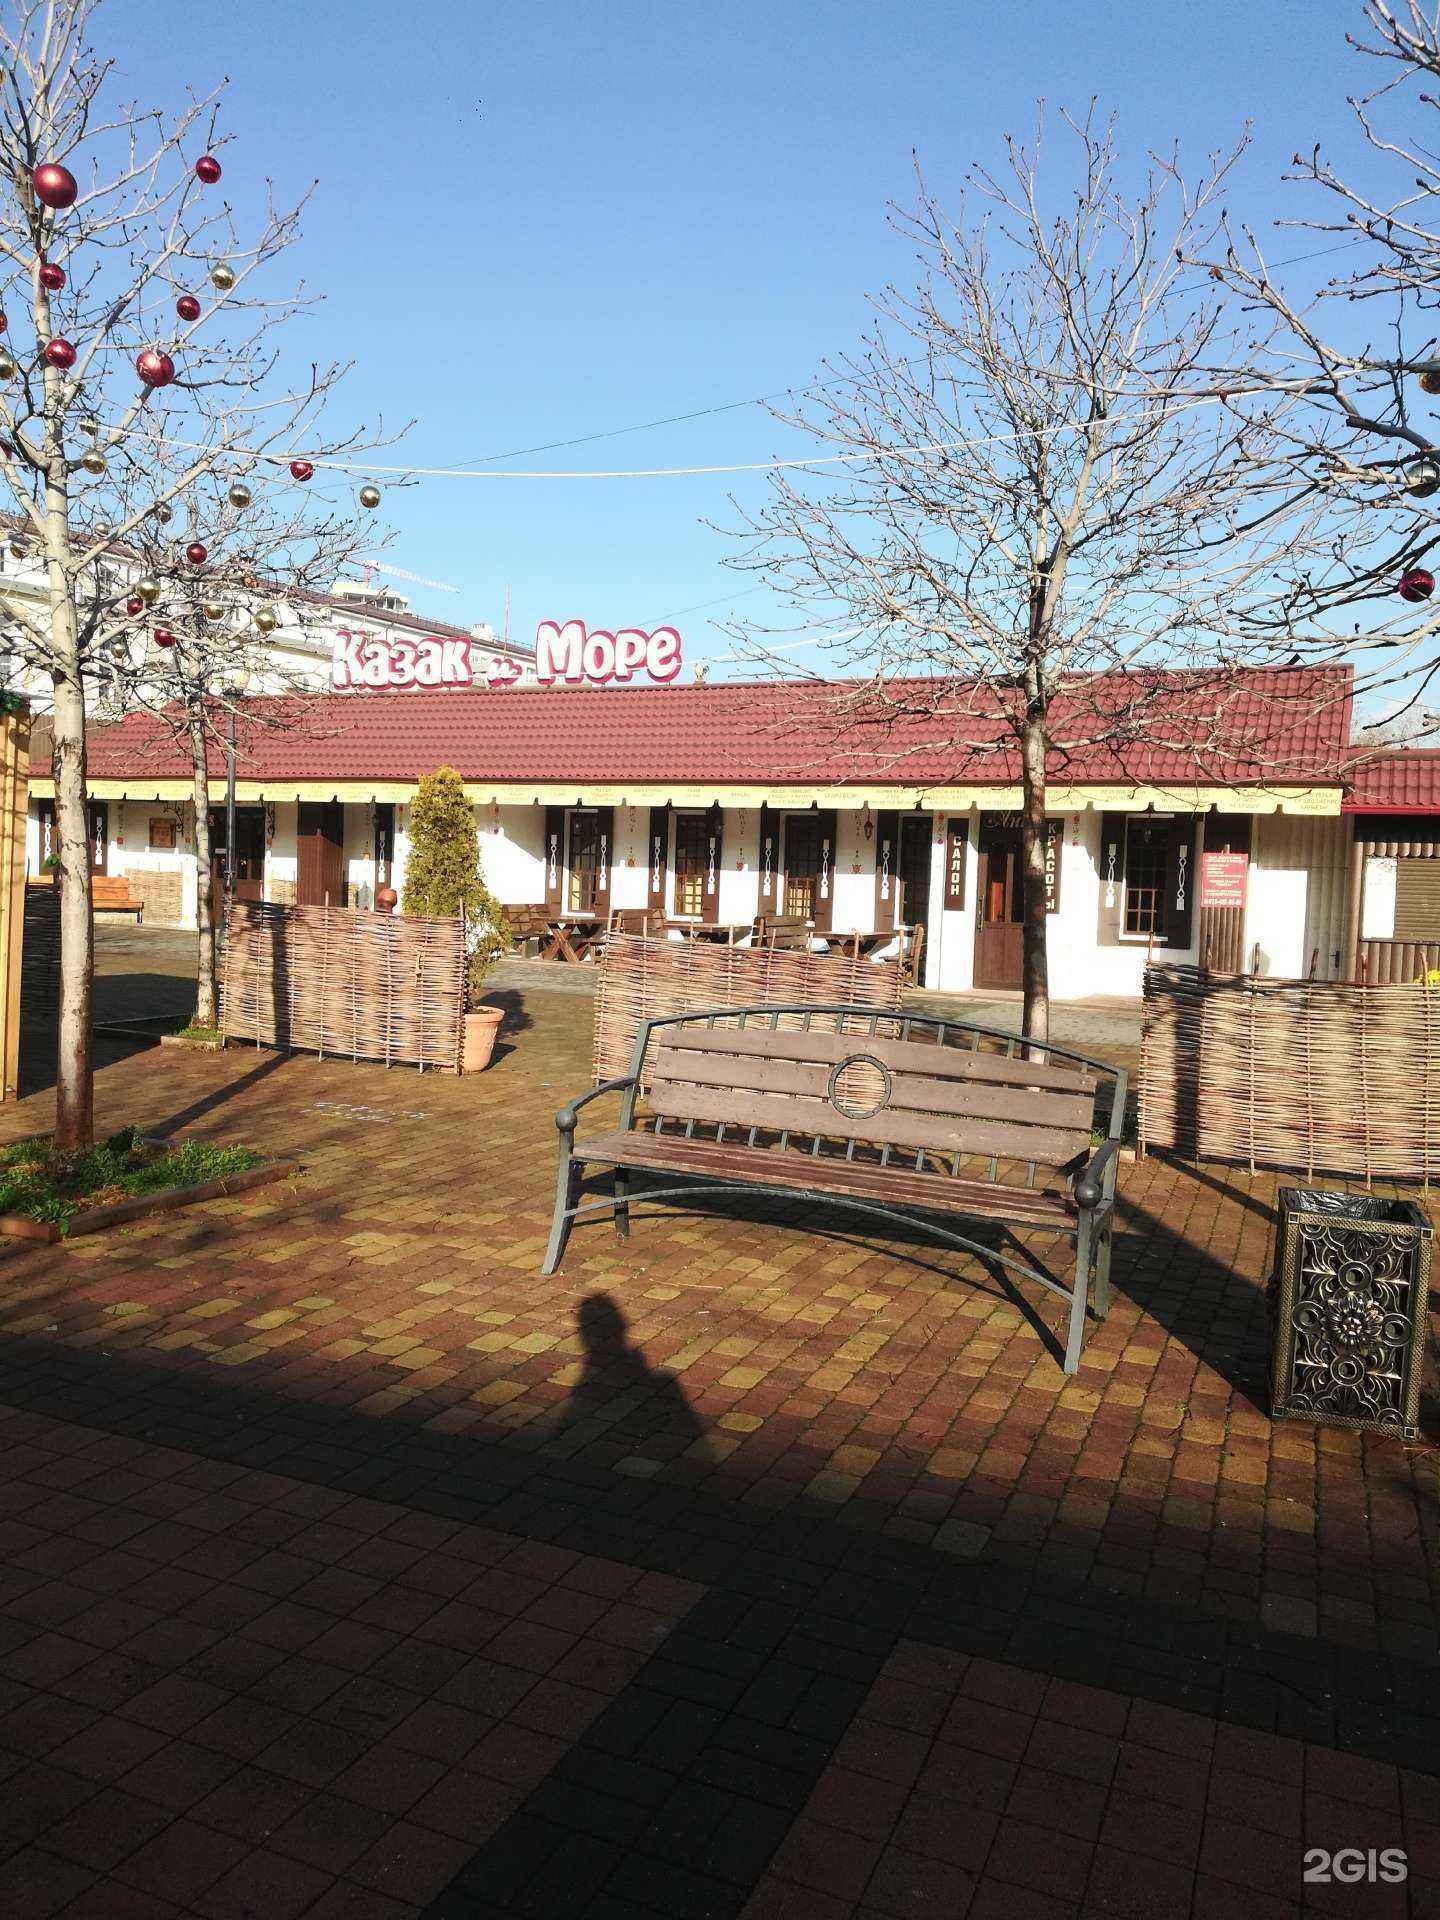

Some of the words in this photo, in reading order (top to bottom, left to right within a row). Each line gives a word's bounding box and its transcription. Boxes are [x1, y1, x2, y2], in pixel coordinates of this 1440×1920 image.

[332, 630, 472, 691] Казак
[486, 657, 522, 689] и
[535, 619, 682, 684] Море
[950, 836, 962, 896] САЛОН
[1045, 822, 1057, 910] КРАСОТЫ
